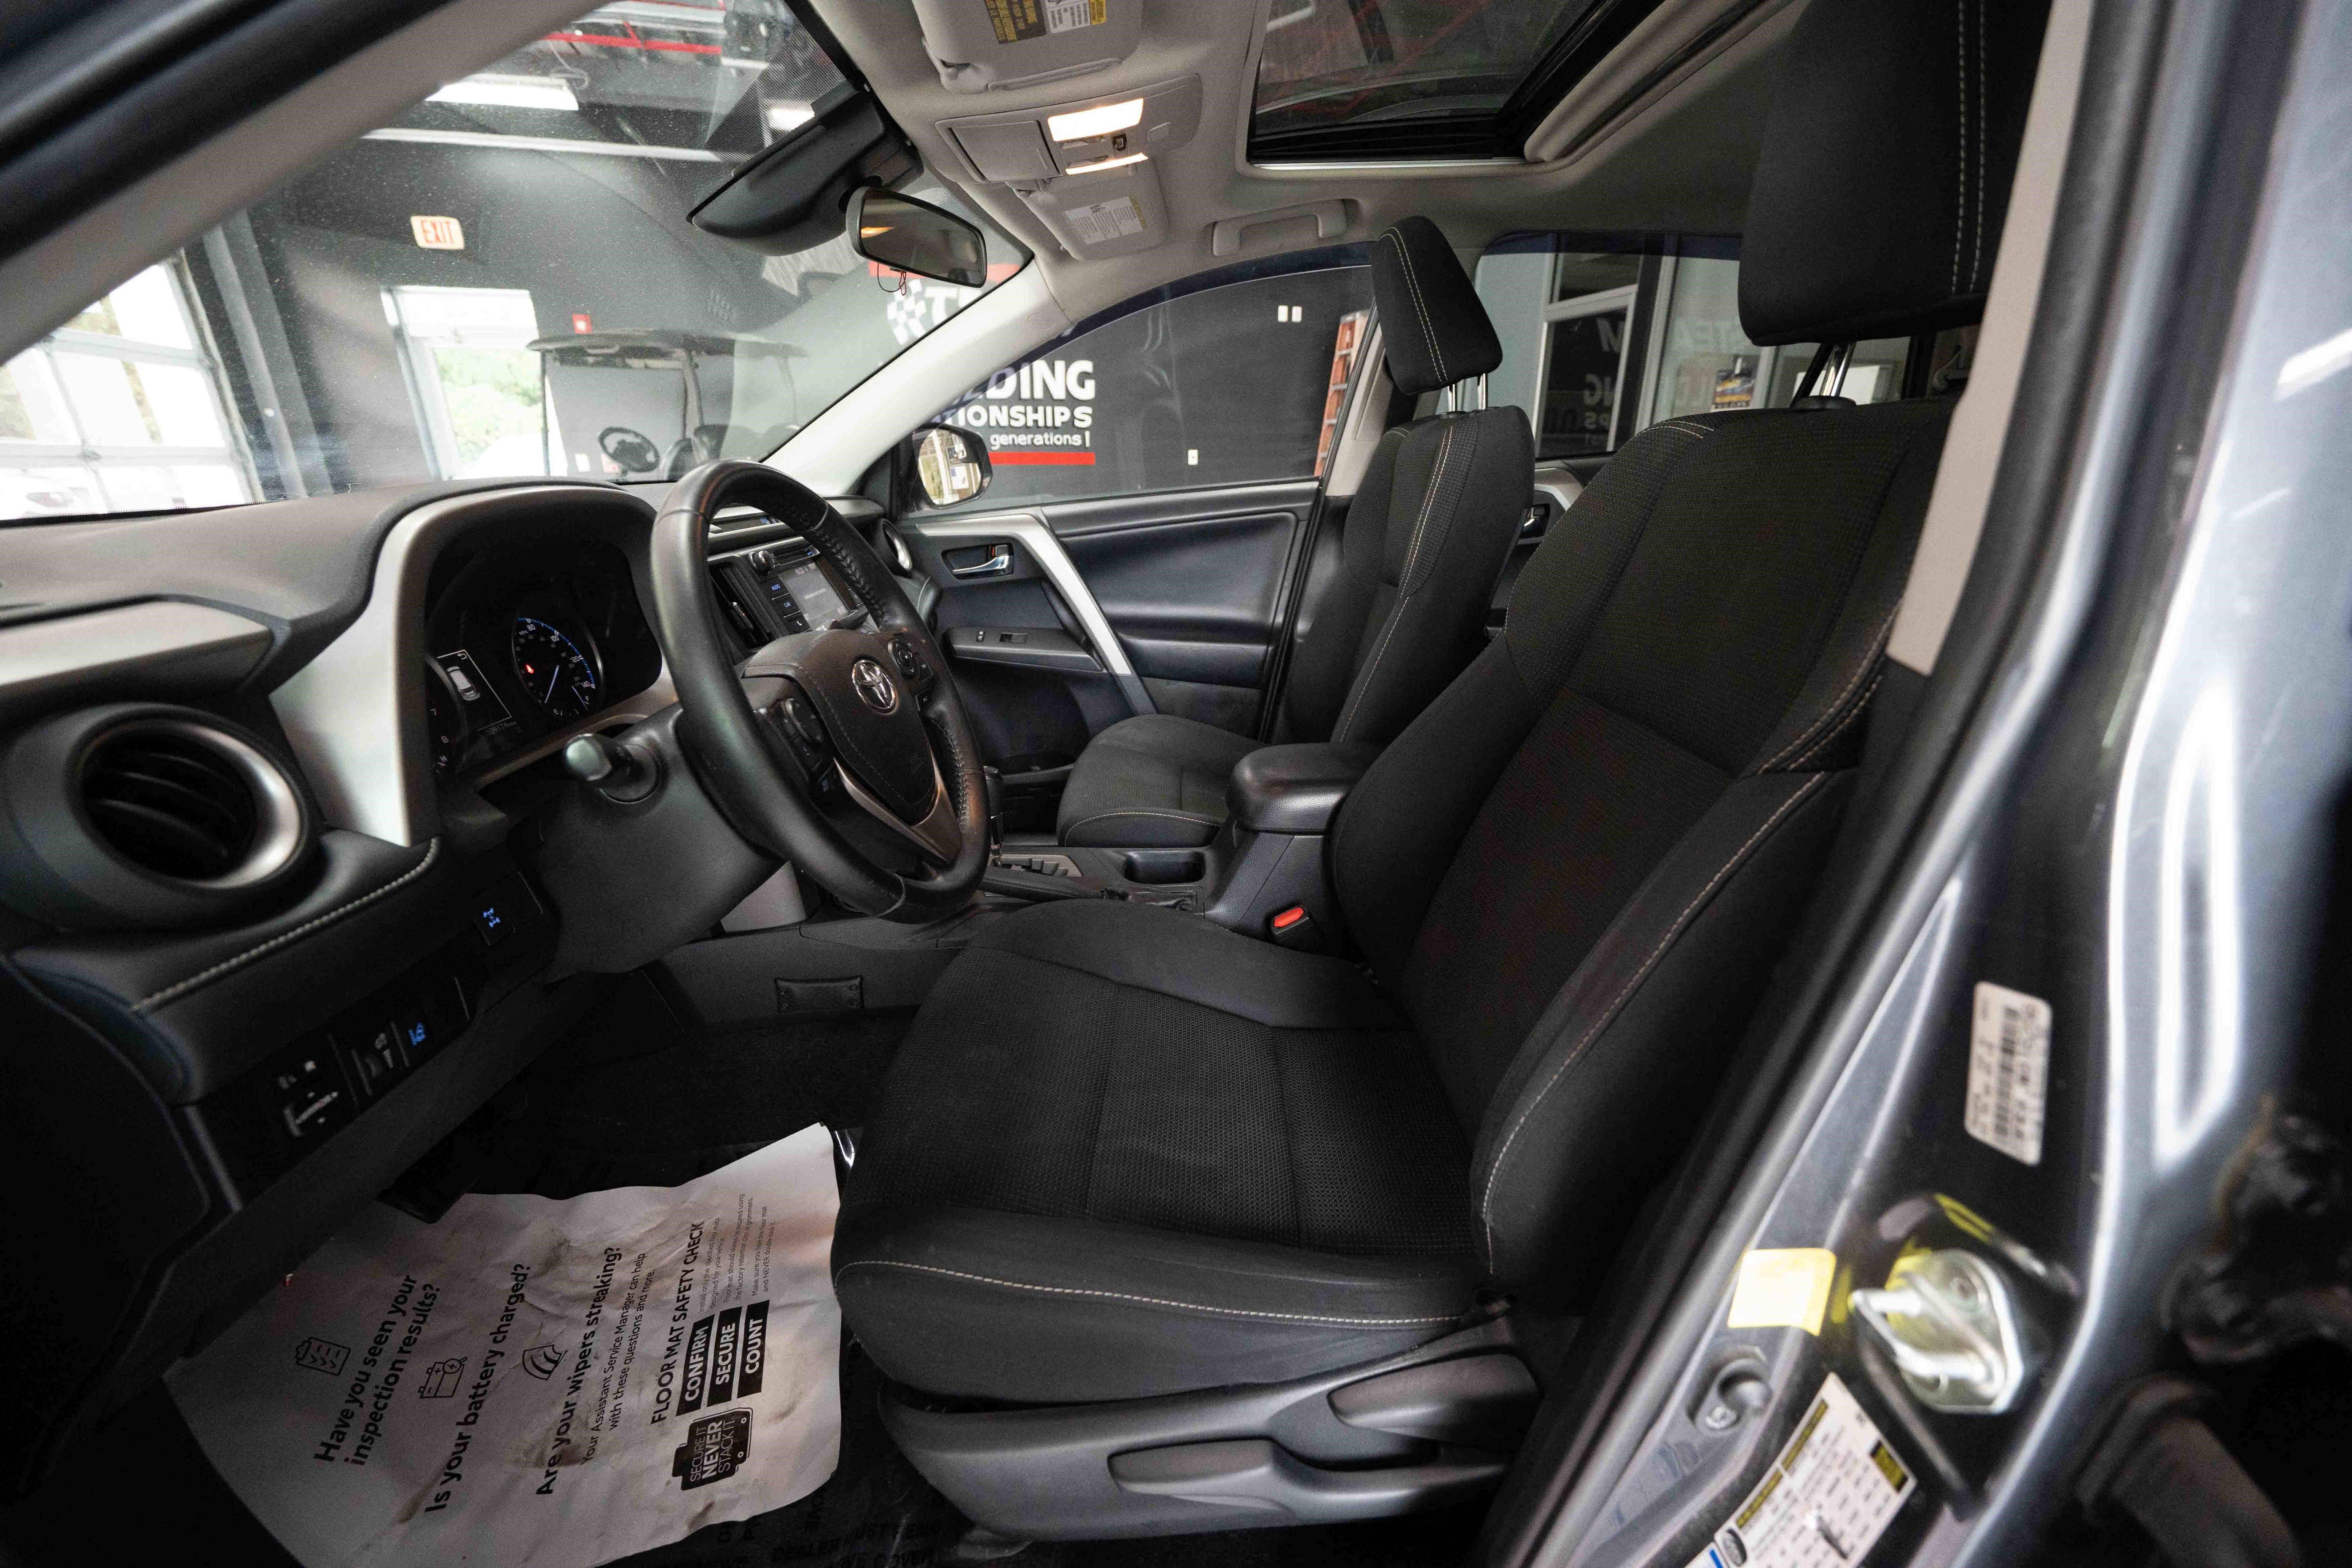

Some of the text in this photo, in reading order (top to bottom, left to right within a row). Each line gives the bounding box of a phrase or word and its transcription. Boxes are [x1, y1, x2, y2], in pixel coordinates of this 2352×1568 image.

[420, 219, 455, 245] EXIT
[698, 1293, 706, 1313] Install
[702, 1279, 710, 1292] only
[709, 1280, 719, 1309] designed
[736, 1267, 745, 1290] factory
[609, 1269, 655, 1431] with these questions and more.
[650, 1220, 705, 1425] FLOOR MAT SAFETY CHECK
[745, 1319, 763, 1374] COUNT
[313, 1274, 417, 1462] Have you seen your
[344, 1283, 441, 1466] inspection results?
[536, 1247, 623, 1495] Are your wipers streaking?
[580, 1253, 647, 1466] Your Assistant Service Manager can help
[684, 1325, 710, 1401] CONFIRM
[715, 1323, 736, 1385] SECURE
[424, 1263, 531, 1512] Is your battery charged?
[690, 1427, 706, 1482] SECURE IT
[702, 1420, 723, 1479] NEVER
[718, 1420, 735, 1473] STACK IT
